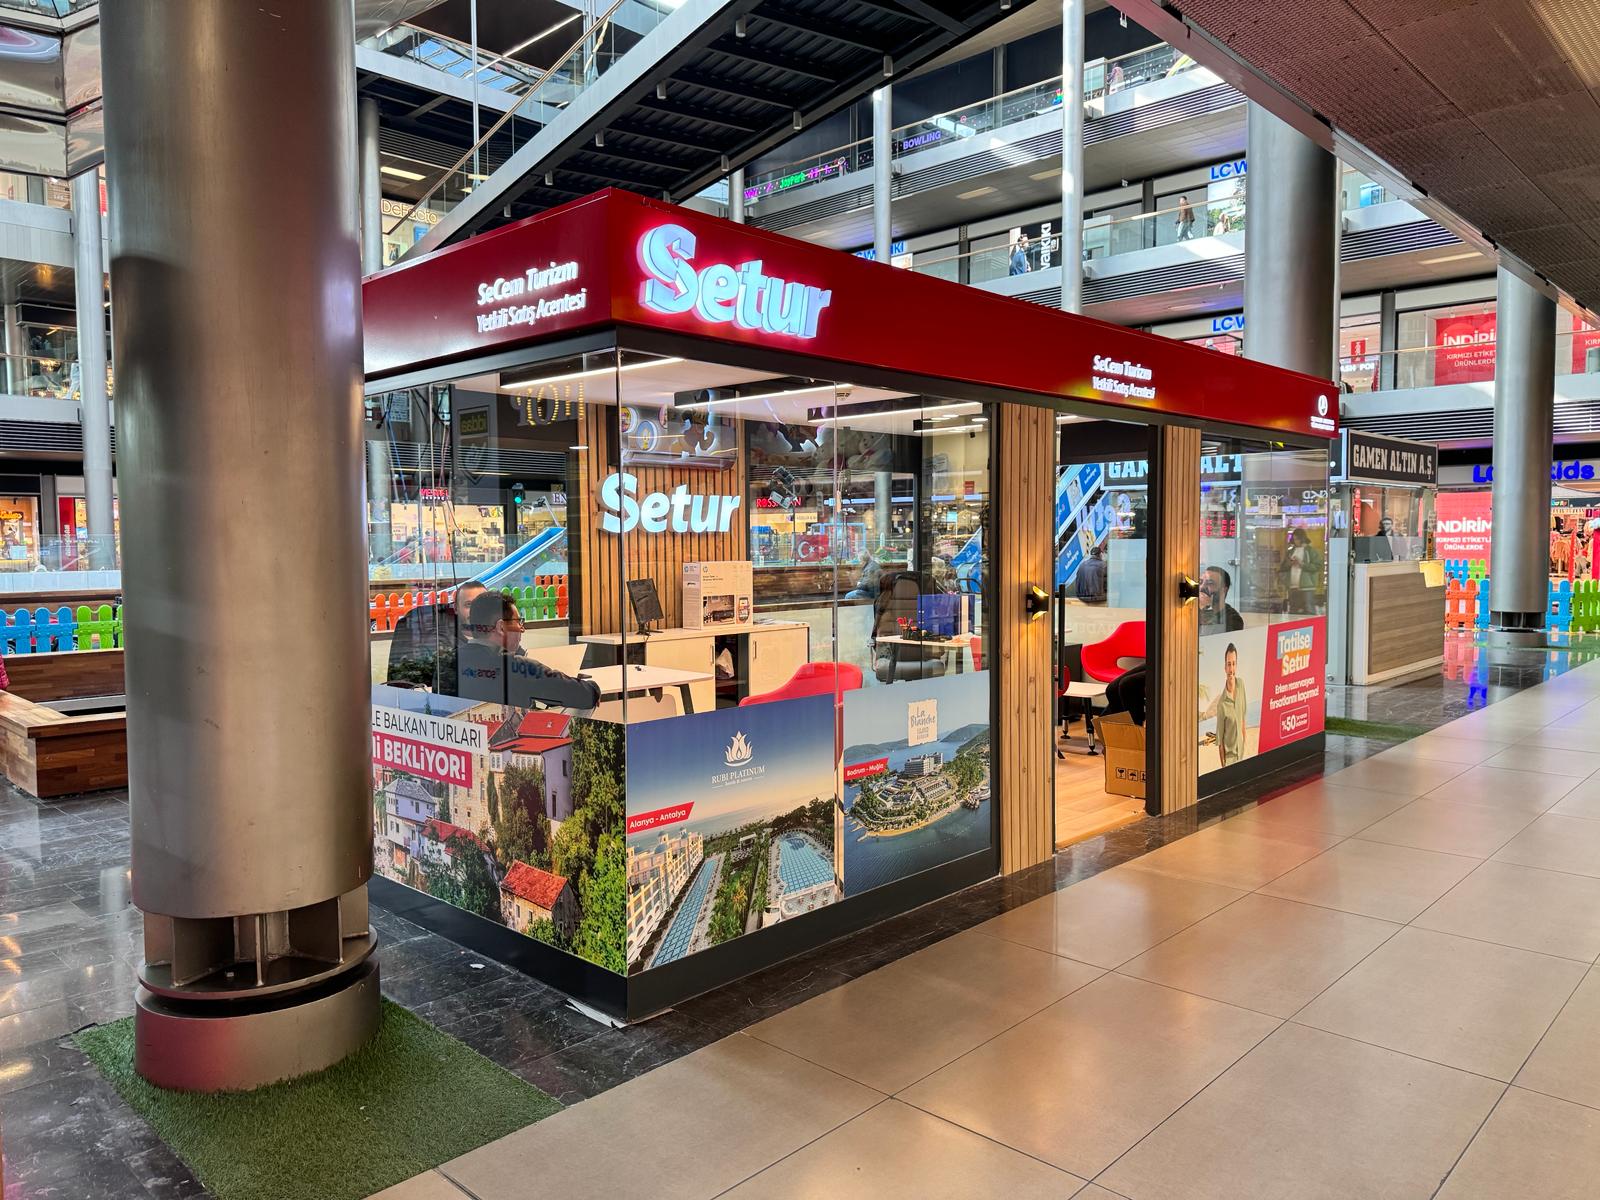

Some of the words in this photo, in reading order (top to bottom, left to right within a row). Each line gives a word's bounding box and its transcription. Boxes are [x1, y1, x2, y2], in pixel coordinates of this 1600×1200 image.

[902, 130, 941, 150] BOWLING
[381, 200, 438, 224] DeFacto
[477, 278, 524, 305] SeCem
[526, 261, 579, 291] Turizm
[636, 223, 832, 339] Setur
[477, 308, 508, 333] Yetkili
[536, 288, 587, 318] Acentesi
[1443, 328, 1496, 349] İNDİRİ
[1123, 361, 1152, 381] Turizm
[1353, 444, 1388, 471] GAMEN
[1390, 450, 1418, 474] ALTIN
[1419, 454, 1434, 480] A.Ş.
[601, 472, 740, 533] Setur
[1279, 630, 1311, 654] Tatilse
[1282, 654, 1310, 677] Setur
[384, 711, 428, 737] BALKAN
[430, 721, 481, 749] TURLARI
[711, 773, 729, 785] RUBI
[730, 765, 765, 780] PLATINUM
[847, 767, 866, 777] Bodrum
[629, 816, 654, 829] Alanya
[660, 808, 686, 822] Antalya
